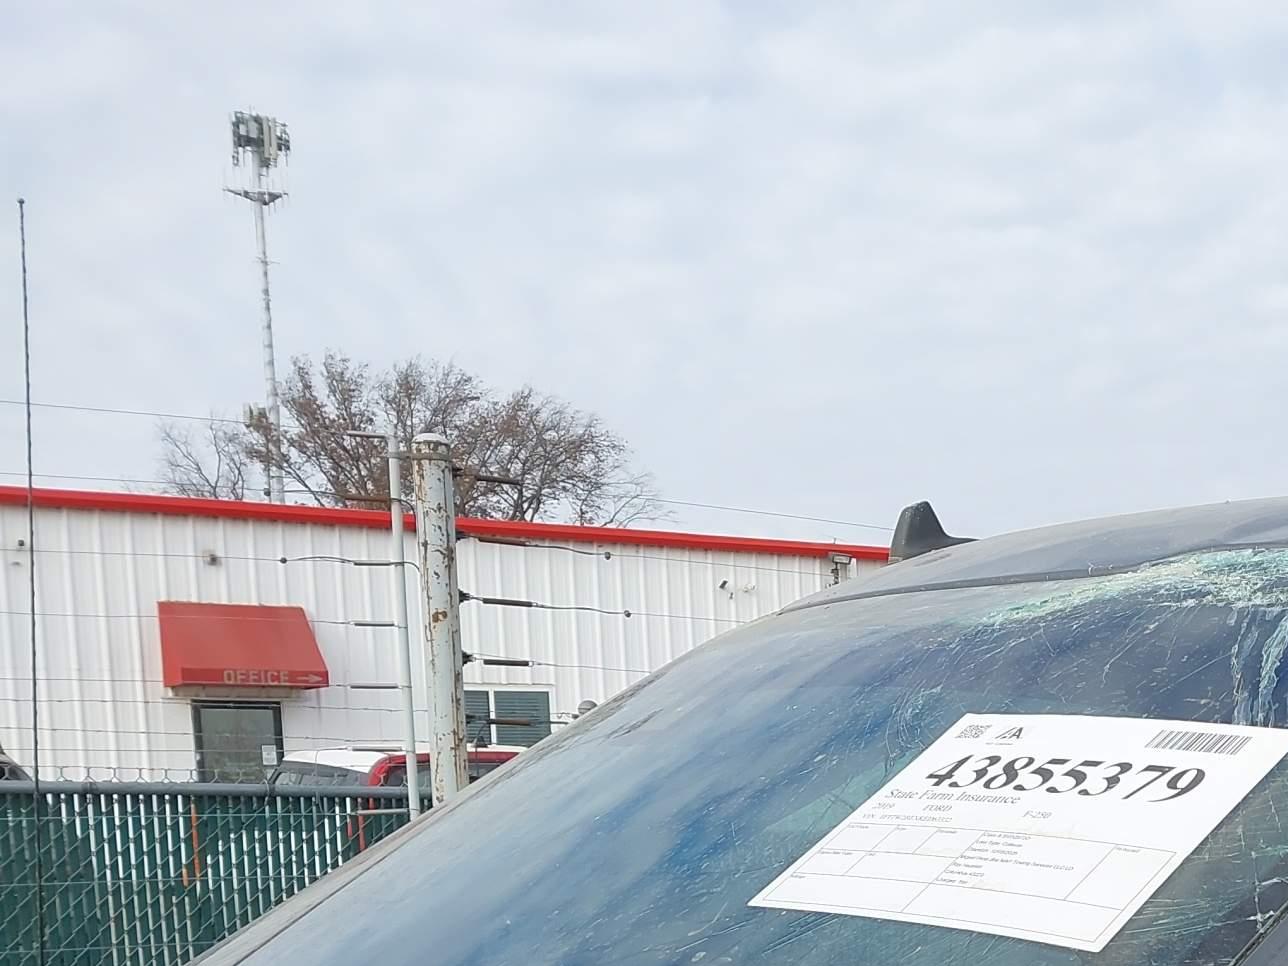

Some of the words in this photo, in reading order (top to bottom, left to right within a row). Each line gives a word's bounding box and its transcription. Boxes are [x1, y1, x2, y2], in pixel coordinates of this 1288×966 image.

[224, 670, 289, 684] OFFICE
[925, 754, 1206, 803] 43855379
[885, 789, 918, 799] State
[919, 790, 954, 800] Farm
[955, 791, 1020, 804] Insurance
[922, 804, 953, 812] FORD
